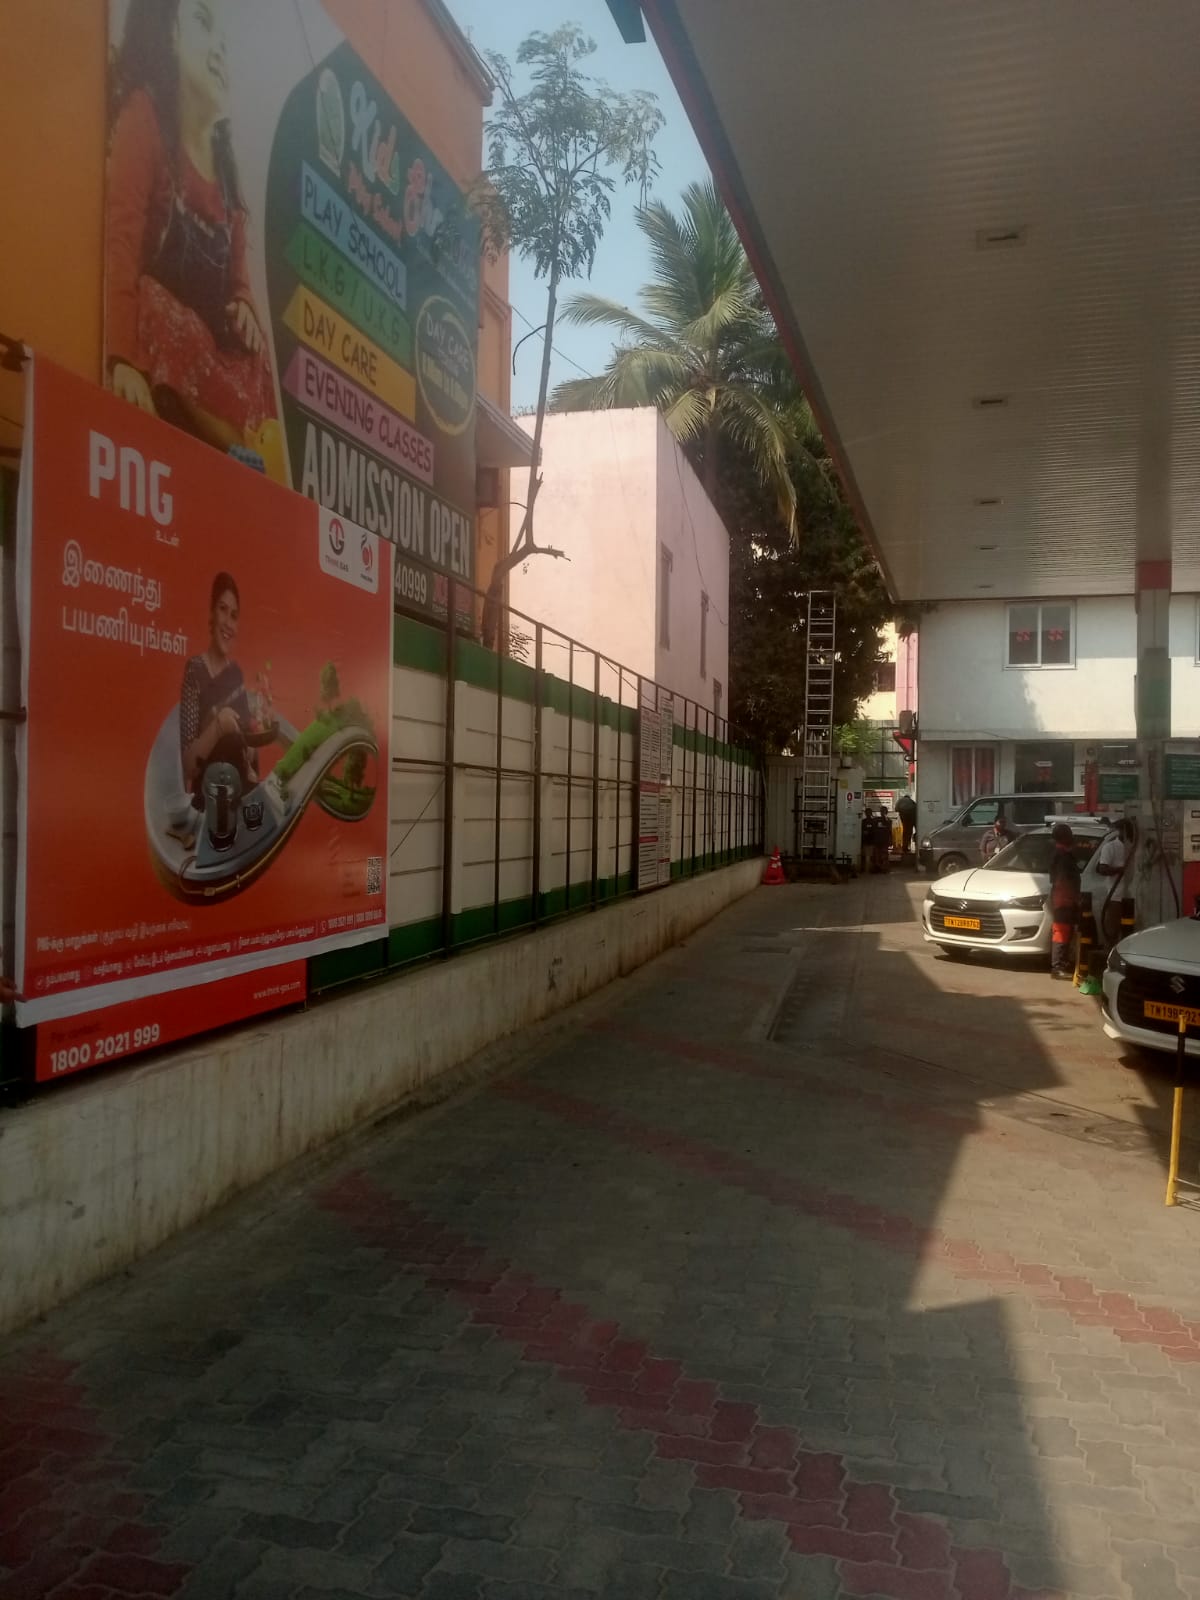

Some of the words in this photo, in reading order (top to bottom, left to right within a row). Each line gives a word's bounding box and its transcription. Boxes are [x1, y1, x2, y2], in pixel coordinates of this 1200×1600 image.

[304, 175, 343, 237] PLAY
[348, 223, 402, 298] SCHOOL
[303, 299, 336, 352] DAY
[341, 334, 377, 386] CARE
[304, 358, 374, 434] EVENING
[378, 415, 432, 473] CLASSES
[301, 421, 425, 556] ADMISSION
[429, 499, 471, 580] OPEN
[62, 539, 161, 611] இணைந்து
[62, 606, 188, 656] பயணியுங்கள்
[51, 1044, 91, 1073] 1800
[95, 1031, 130, 1060] 2021
[134, 1024, 160, 1047] 999
